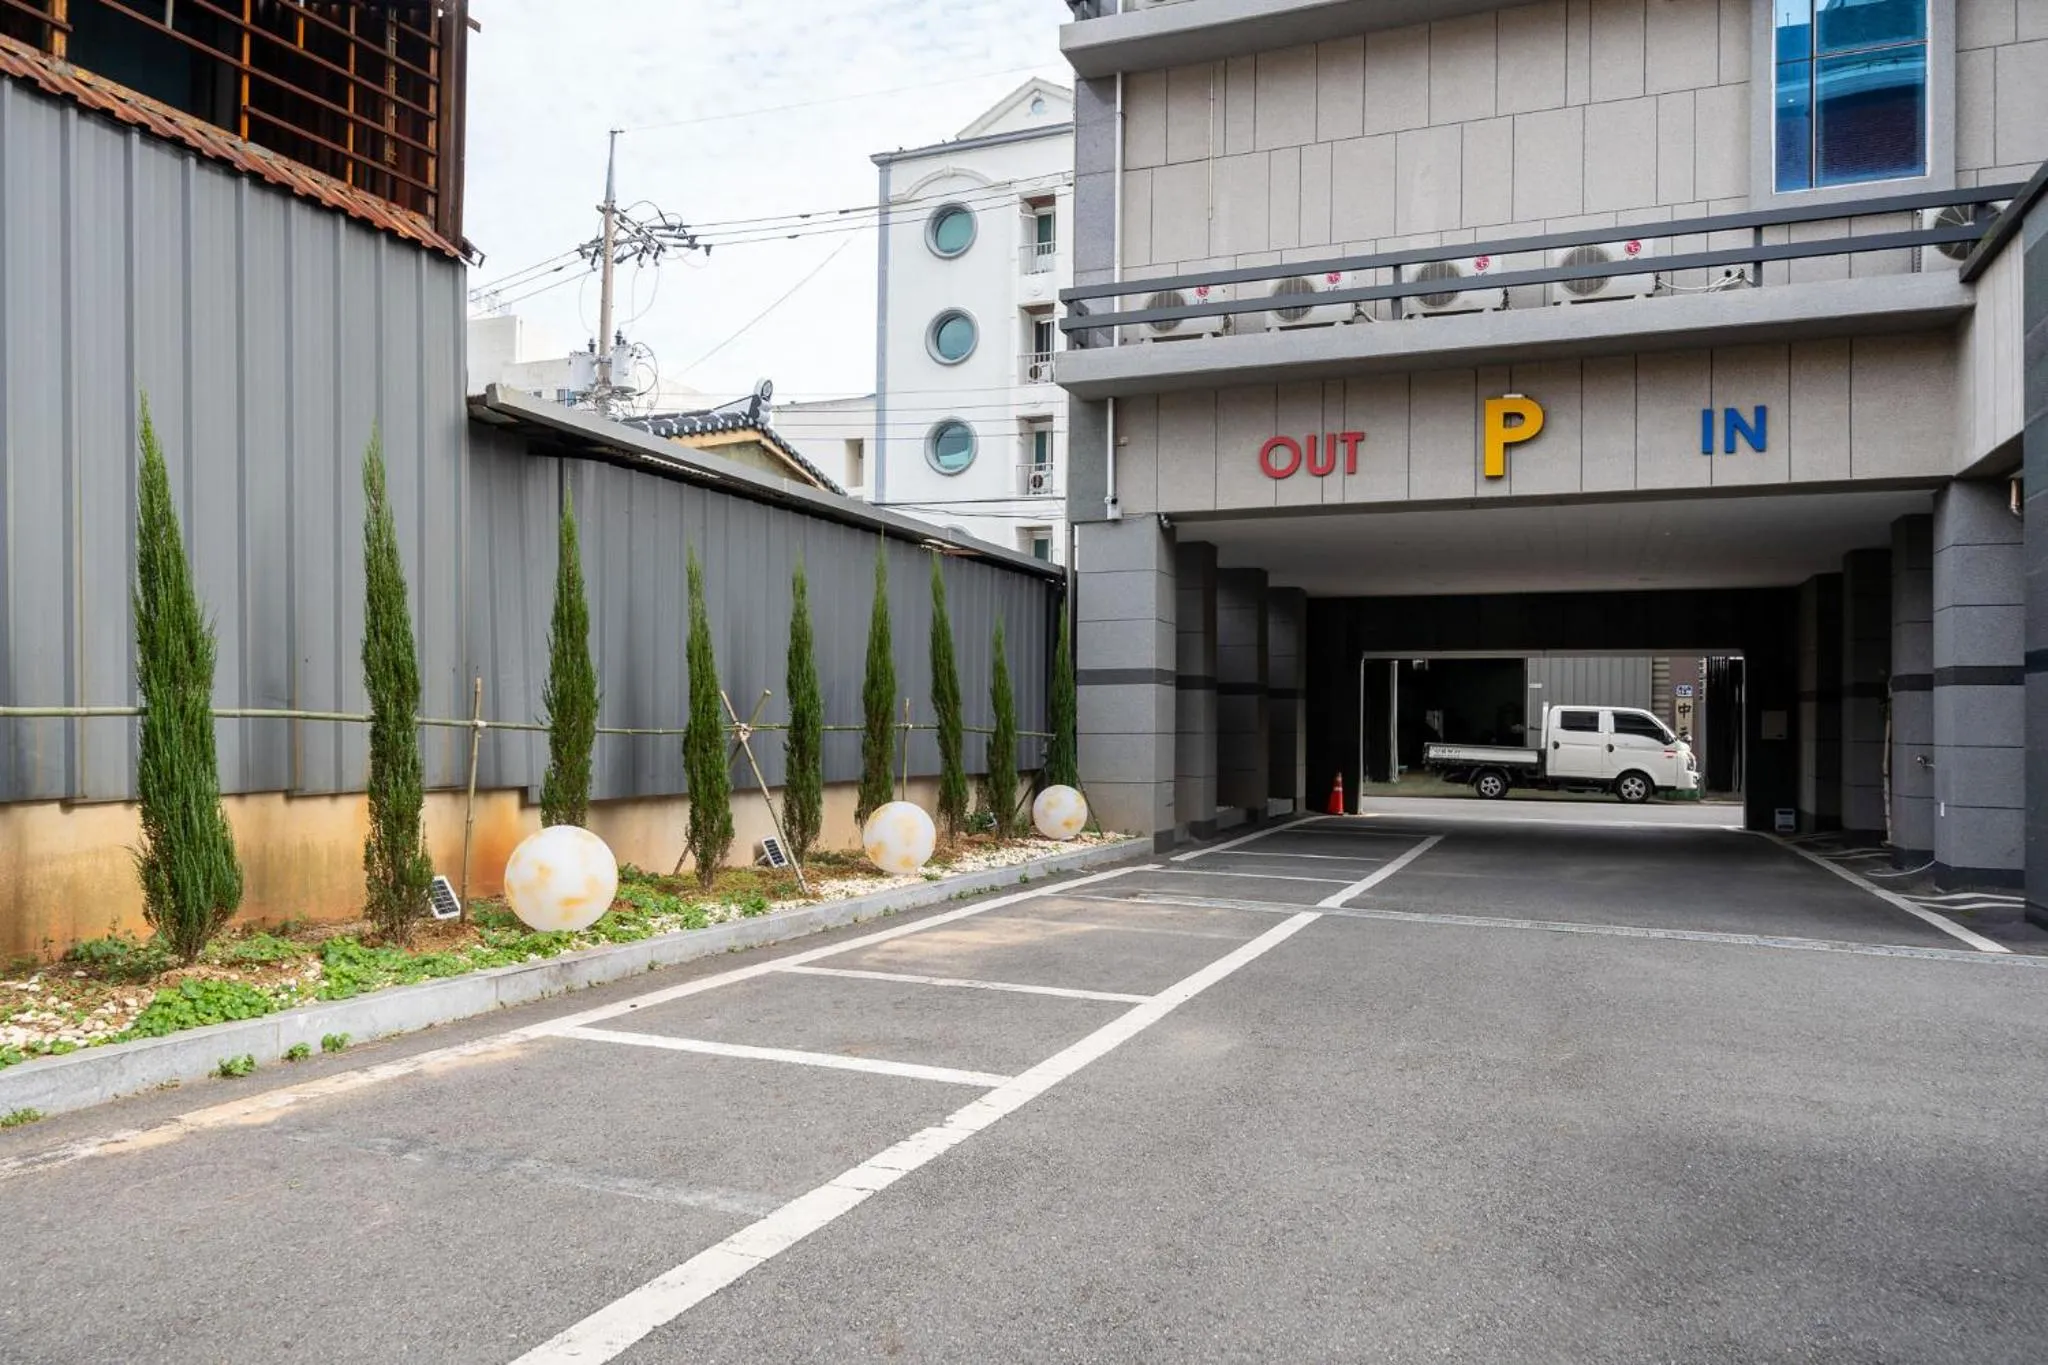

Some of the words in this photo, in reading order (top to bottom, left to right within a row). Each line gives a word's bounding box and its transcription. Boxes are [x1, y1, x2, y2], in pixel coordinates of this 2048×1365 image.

[1485, 396, 1545, 480] P
[1701, 405, 1768, 455] IN
[1259, 432, 1365, 480] OUT
